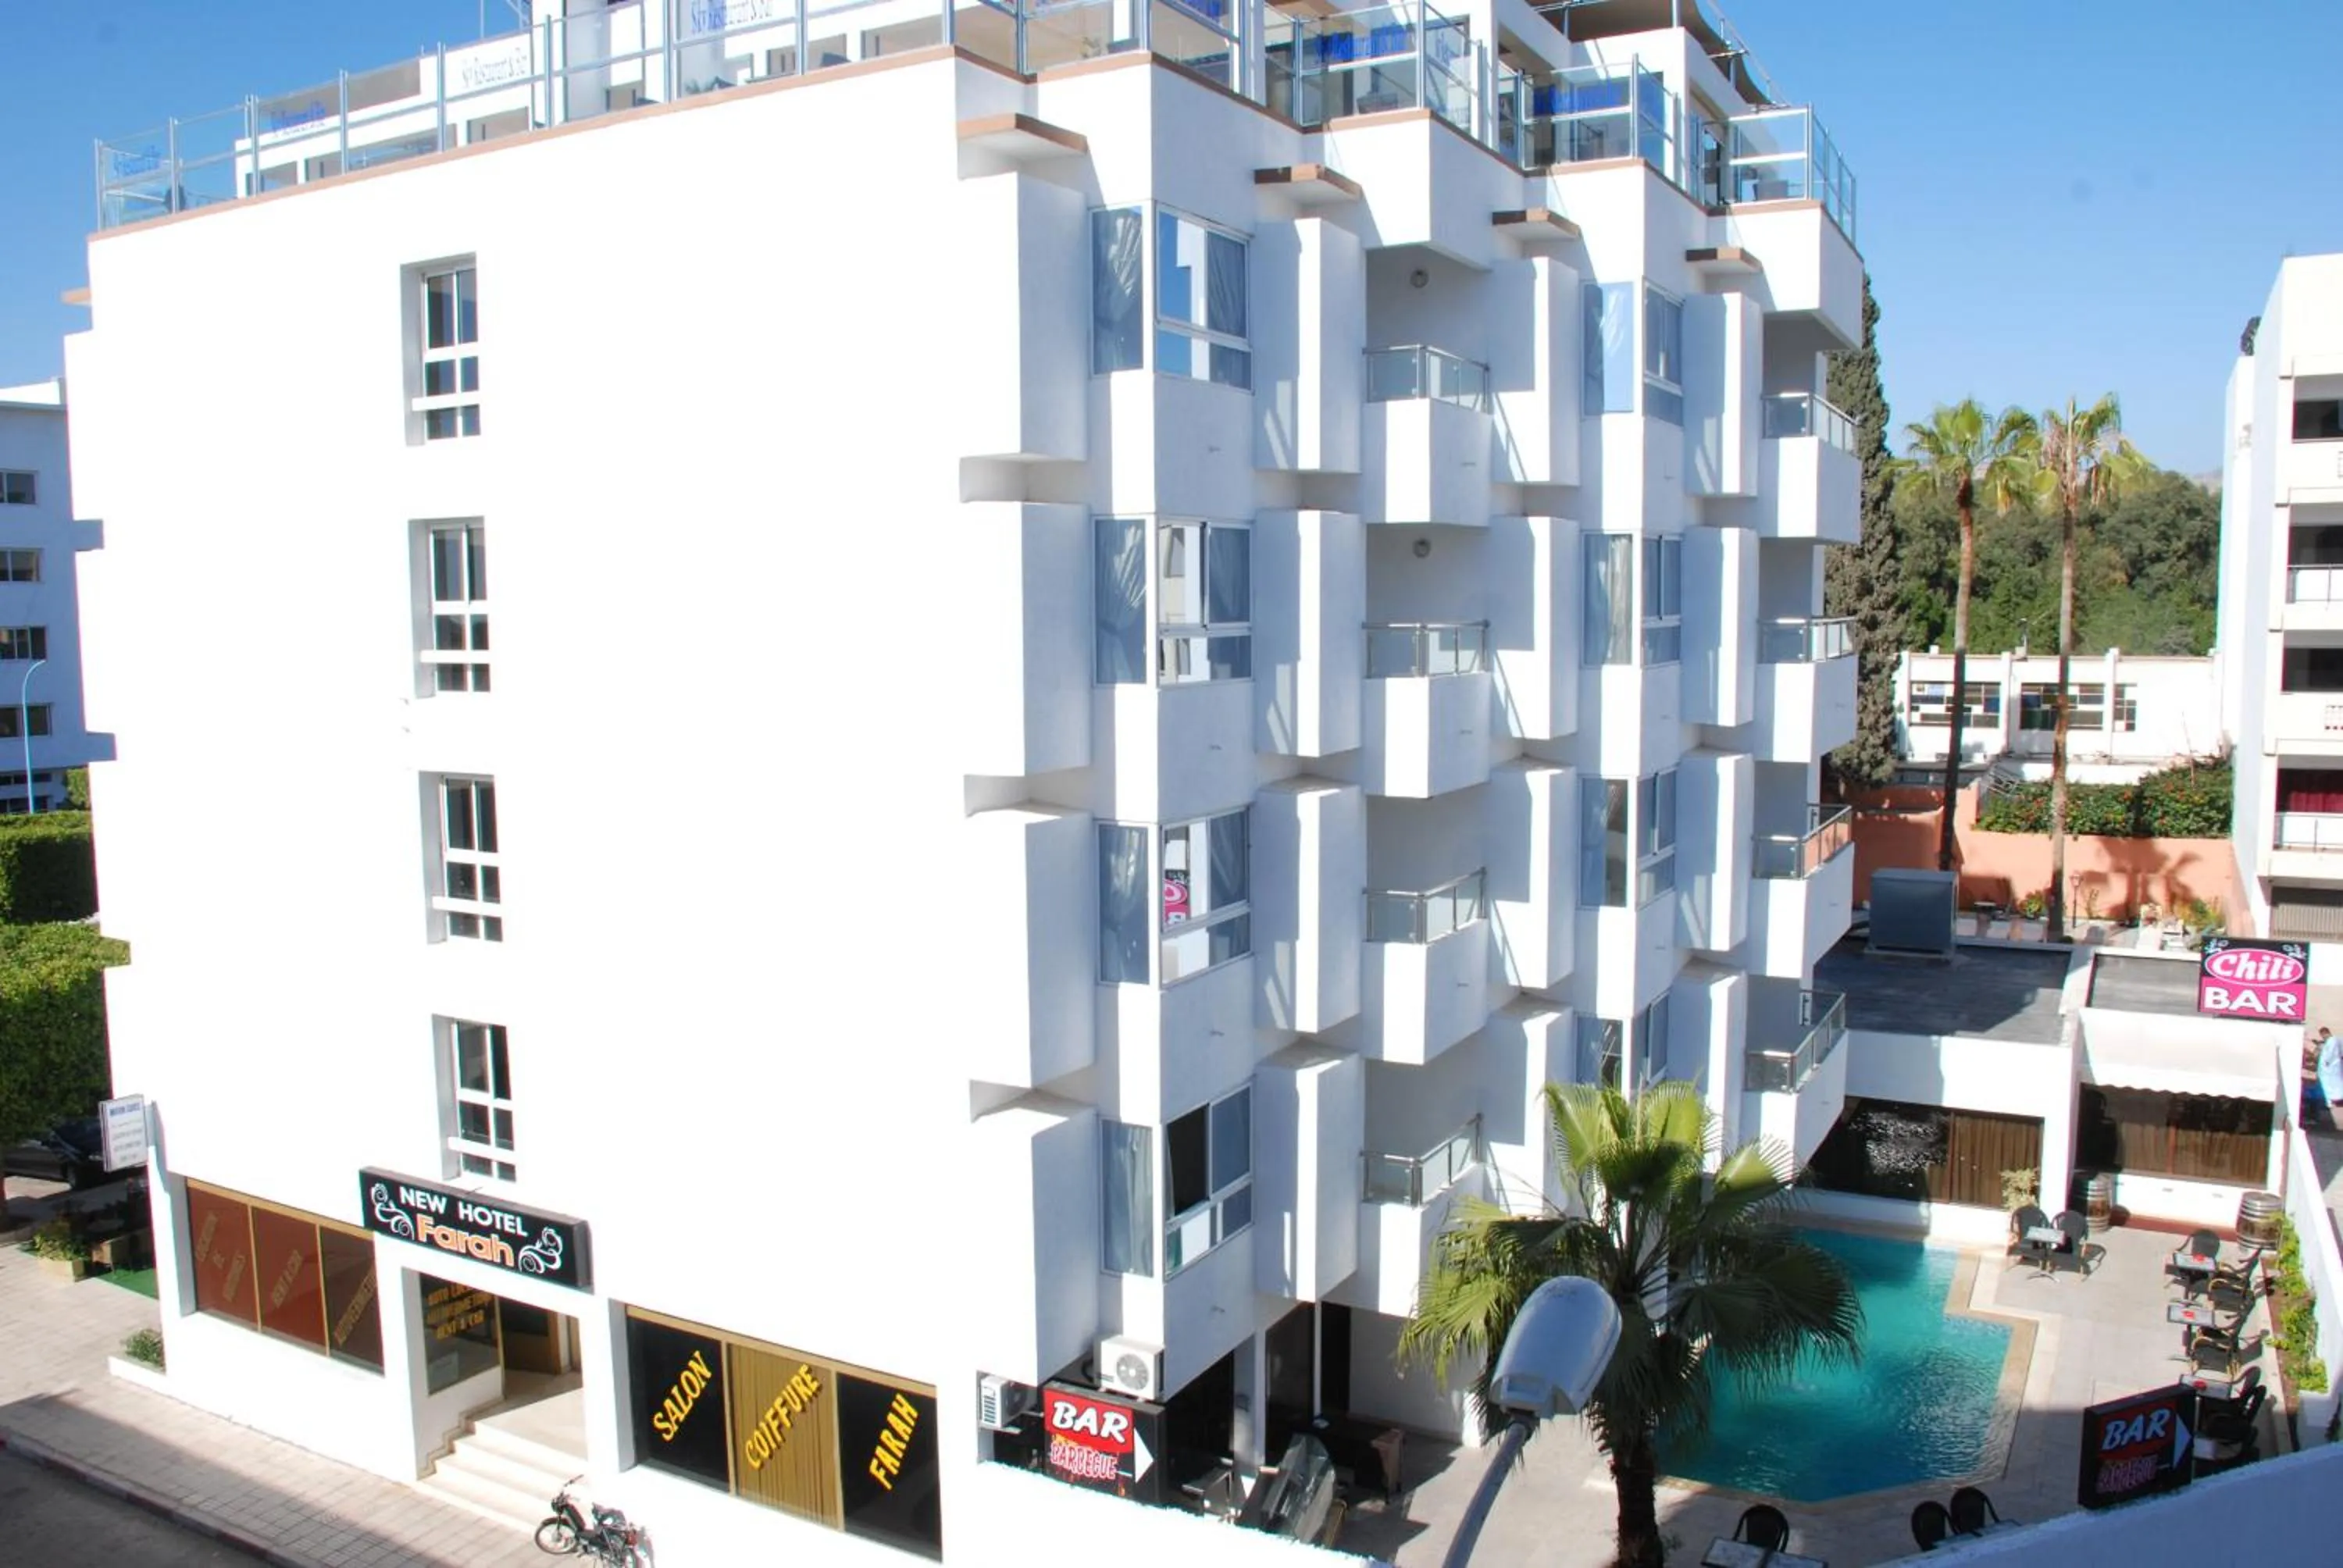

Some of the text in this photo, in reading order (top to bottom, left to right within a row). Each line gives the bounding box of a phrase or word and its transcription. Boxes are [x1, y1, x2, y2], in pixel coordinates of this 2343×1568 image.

[2212, 952, 2296, 981] Chili
[2204, 986, 2298, 1016] BAR
[399, 1185, 528, 1237] NEW HOTEL
[416, 1213, 515, 1267] Farah
[653, 1350, 712, 1442] SALON
[745, 1363, 820, 1470] COIFFURE
[1052, 1400, 1129, 1444] BAR
[868, 1392, 918, 1491] FARAH
[2101, 1408, 2171, 1450] BAR
